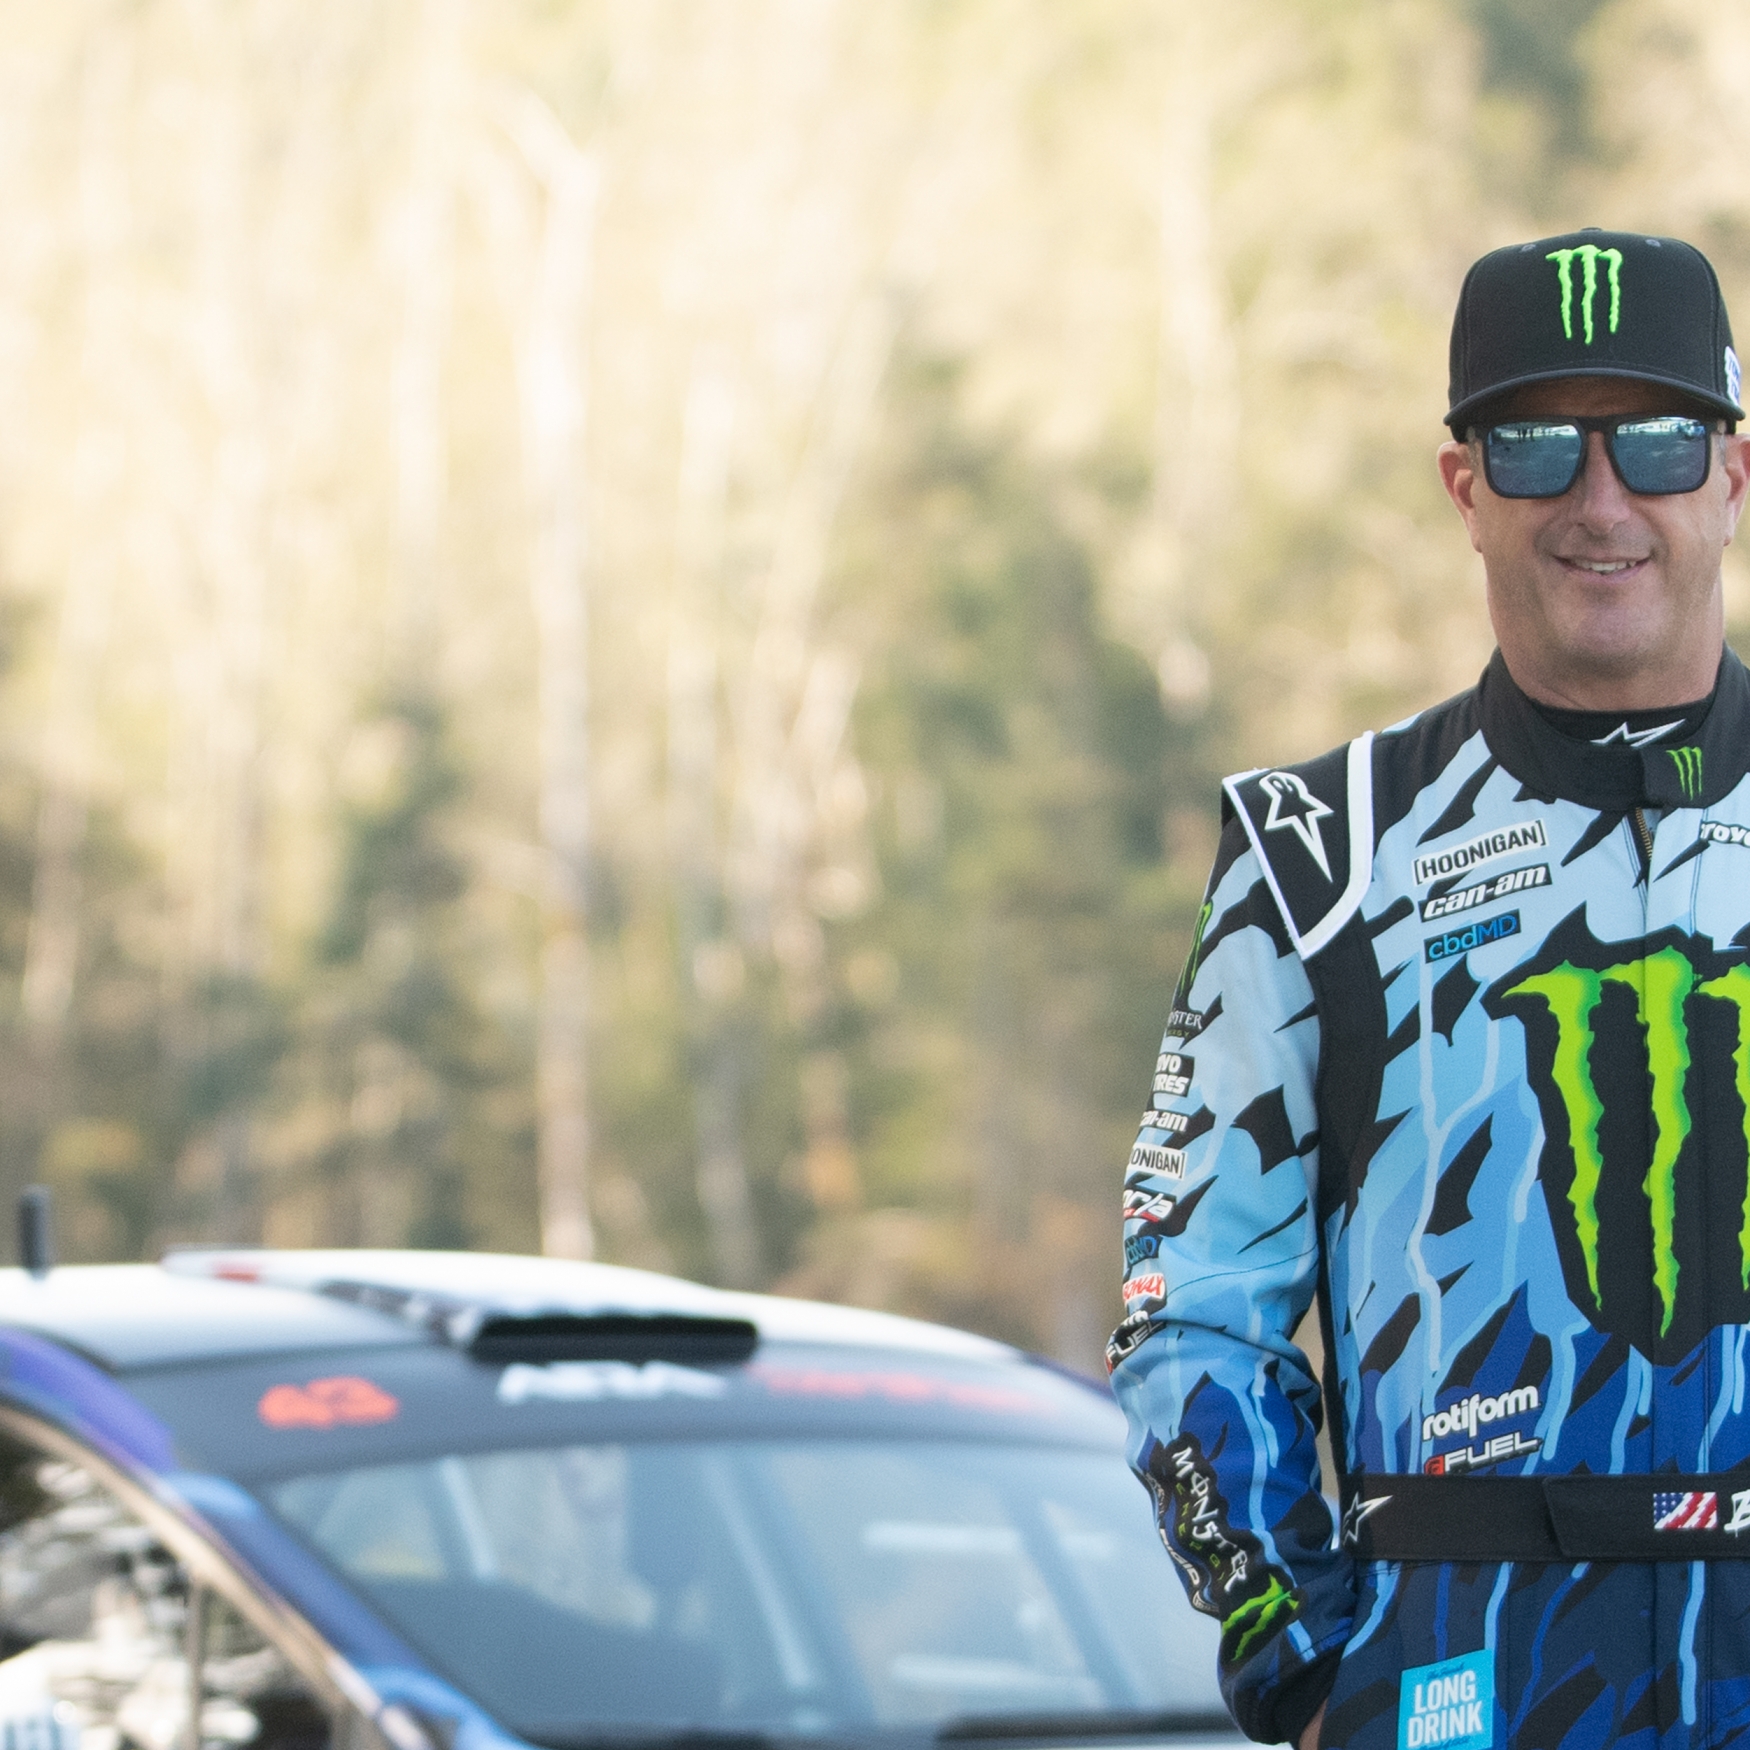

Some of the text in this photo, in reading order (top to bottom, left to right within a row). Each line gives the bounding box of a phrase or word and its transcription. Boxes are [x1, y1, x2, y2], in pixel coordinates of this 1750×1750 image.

[1423, 865, 1547, 919] can-am
[1428, 914, 1517, 959] cbdMD
[1422, 1385, 1539, 1441] rotiform
[1414, 1670, 1476, 1714] LONG
[1407, 1700, 1484, 1748] DRINK
